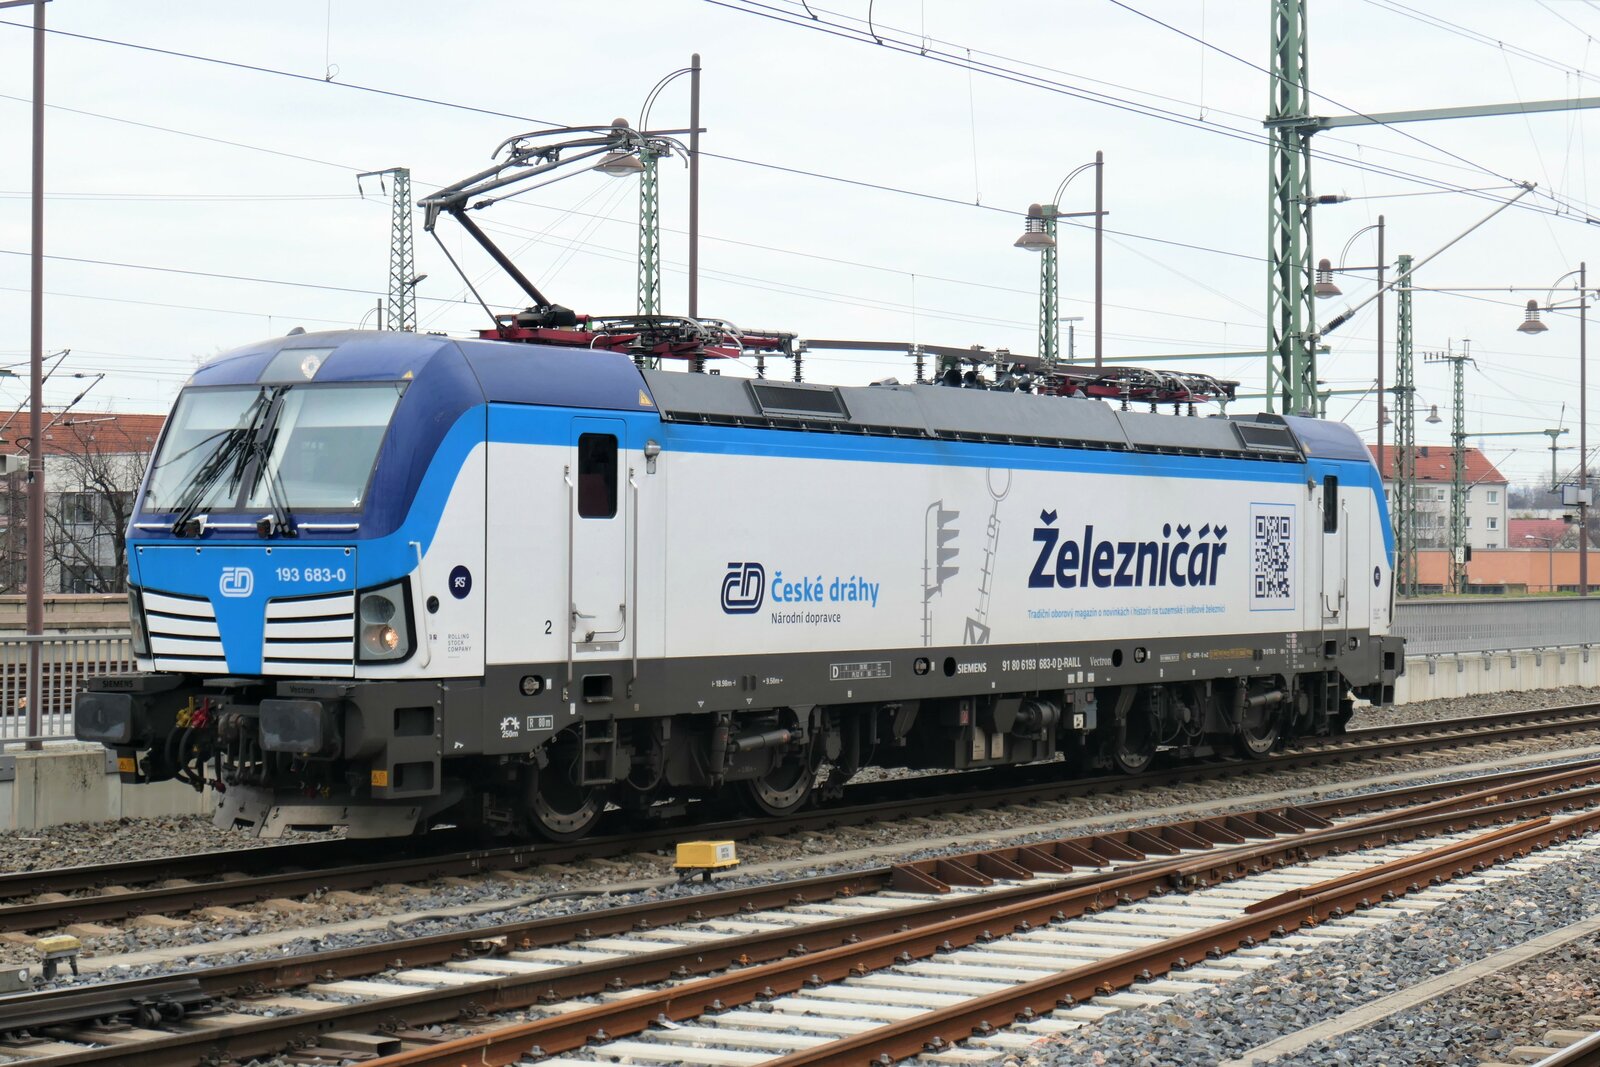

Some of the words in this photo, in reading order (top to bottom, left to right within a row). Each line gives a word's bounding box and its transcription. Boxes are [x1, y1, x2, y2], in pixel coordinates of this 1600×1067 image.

[1028, 508, 1228, 588] Železničář
[275, 568, 300, 582] 193
[304, 568, 346, 582] 683-0
[219, 567, 254, 598] ČD
[721, 562, 765, 615] ČD
[771, 571, 824, 603] České
[829, 575, 880, 608] dráhy
[772, 611, 804, 624] Národní
[805, 612, 841, 626] dopravce
[1028, 608, 1050, 619] Tradiční
[1051, 608, 1074, 620] oborový
[1103, 607, 1129, 617] novinkách
[545, 620, 552, 635] 2
[957, 662, 987, 674] SIEMENS
[1002, 660, 1010, 672] 91
[1012, 659, 1020, 671] 80
[1021, 659, 1036, 671] 6193
[1039, 658, 1056, 670] 683-0
[1057, 657, 1081, 670] D-RAILL
[1090, 656, 1112, 667] Vectron
[832, 666, 839, 679] D
[102, 680, 134, 688] SIEMENS
[529, 718, 534, 728] R
[502, 730, 519, 739] 250m
